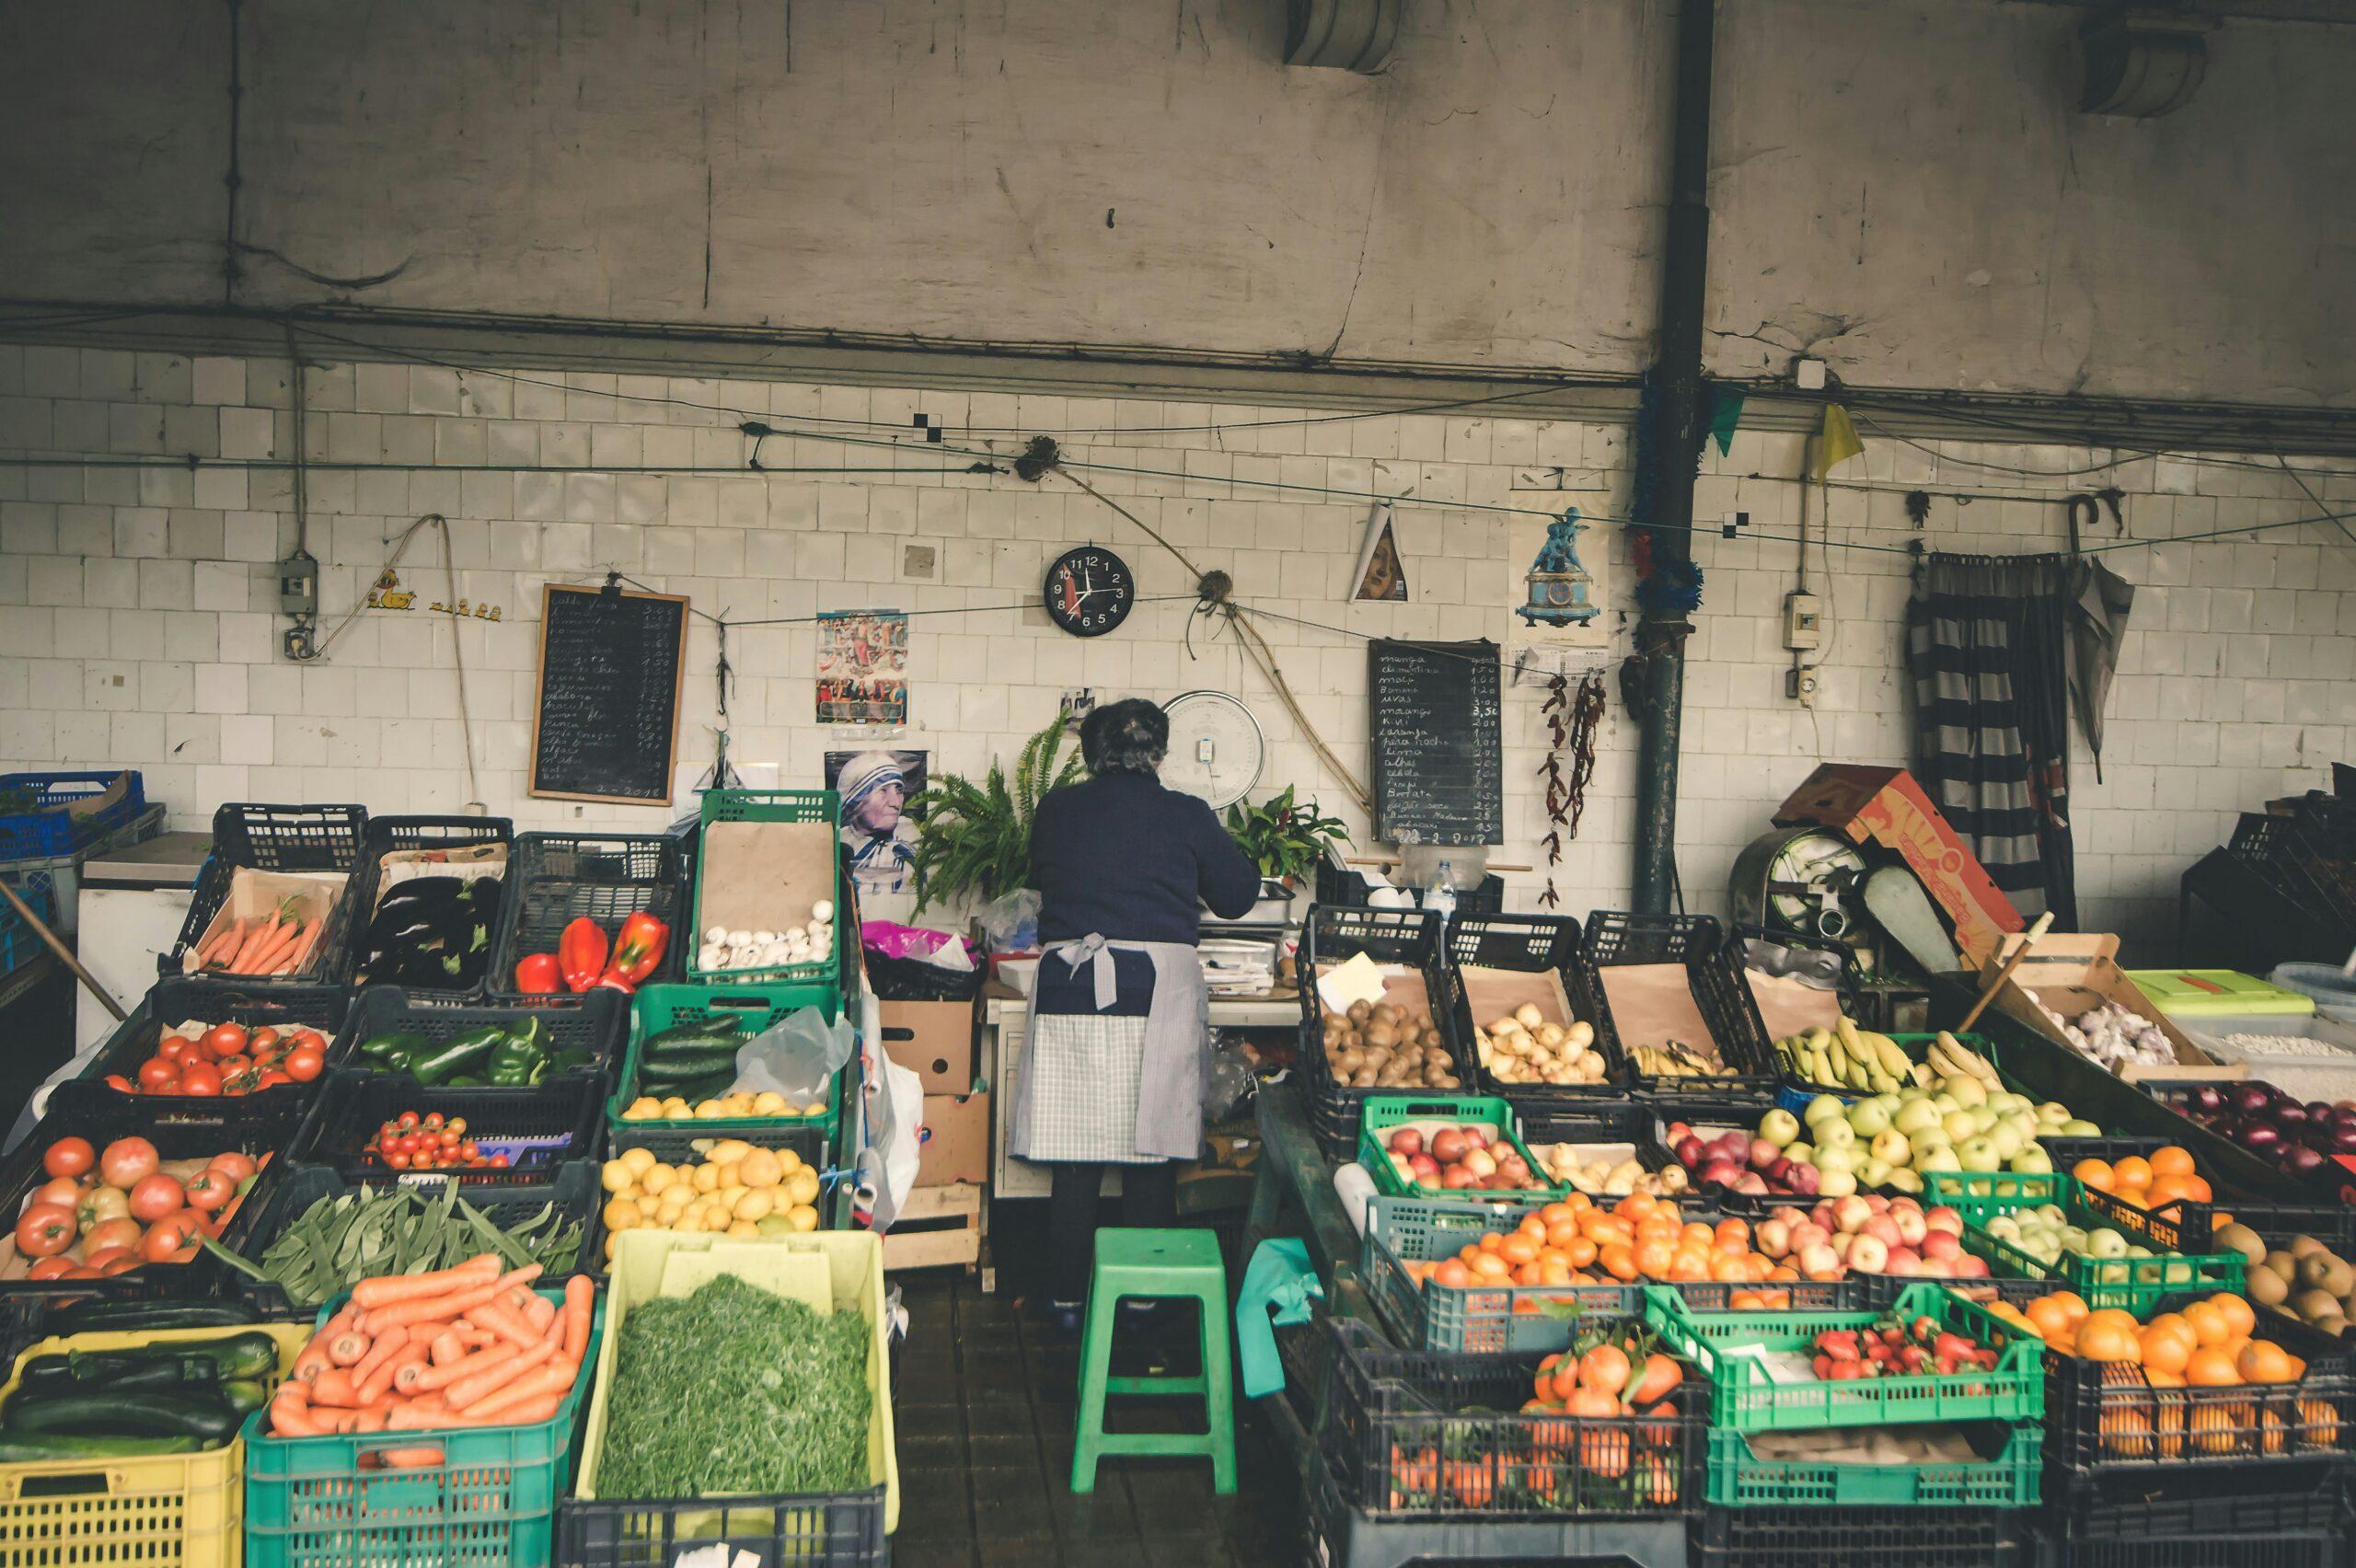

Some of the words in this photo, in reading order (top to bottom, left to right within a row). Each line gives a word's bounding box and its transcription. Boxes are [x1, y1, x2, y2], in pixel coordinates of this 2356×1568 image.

[1070, 559, 1082, 569] 11
[1086, 557, 1099, 567] 12
[1103, 561, 1109, 571] 1
[1059, 571, 1070, 580] 10
[1112, 573, 1120, 583] 2
[1054, 584, 1062, 594] 9
[1115, 589, 1124, 599] 3
[1057, 600, 1066, 610] 8
[1110, 604, 1117, 614] 4
[1082, 617, 1091, 627] 6
[1098, 614, 1106, 624] 5
[1379, 656, 1426, 667] manga
